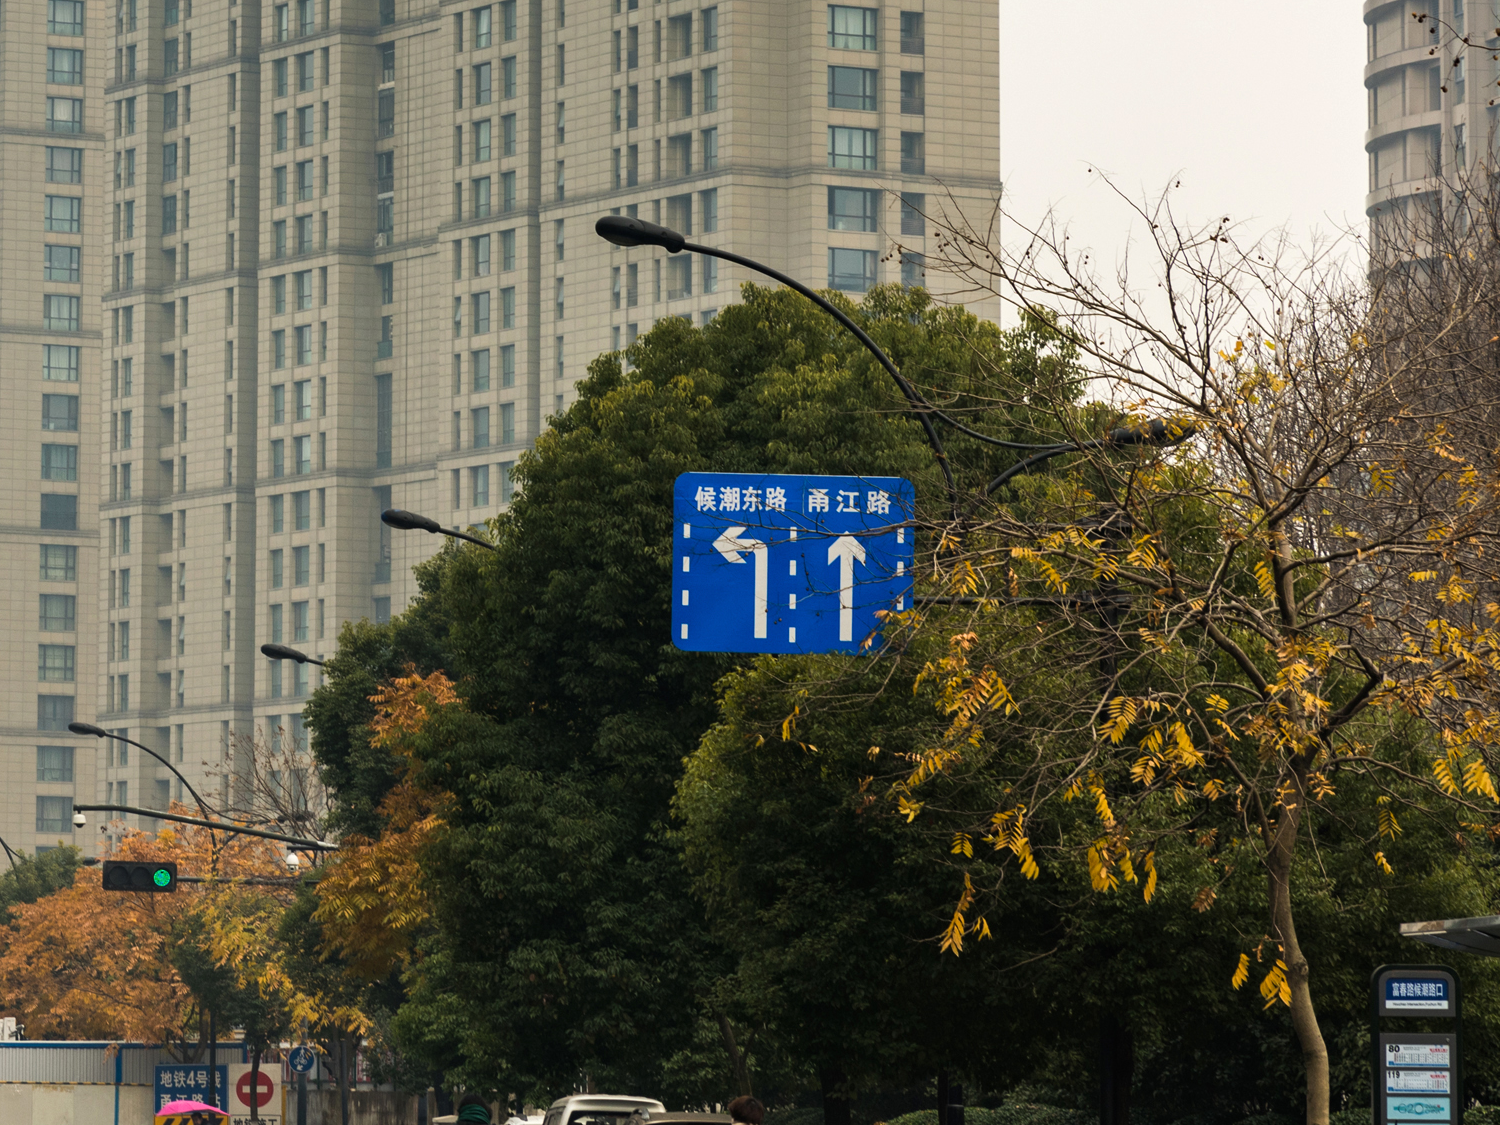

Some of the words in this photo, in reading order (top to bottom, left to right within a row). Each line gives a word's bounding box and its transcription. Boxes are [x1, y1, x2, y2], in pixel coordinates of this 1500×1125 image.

[694, 486, 787, 513] 候潮东路
[808, 488, 892, 515] 甬江路
[1388, 1044, 1400, 1053] 80
[160, 1070, 222, 1088] 地铁4号线
[1388, 1070, 1400, 1079] 119
